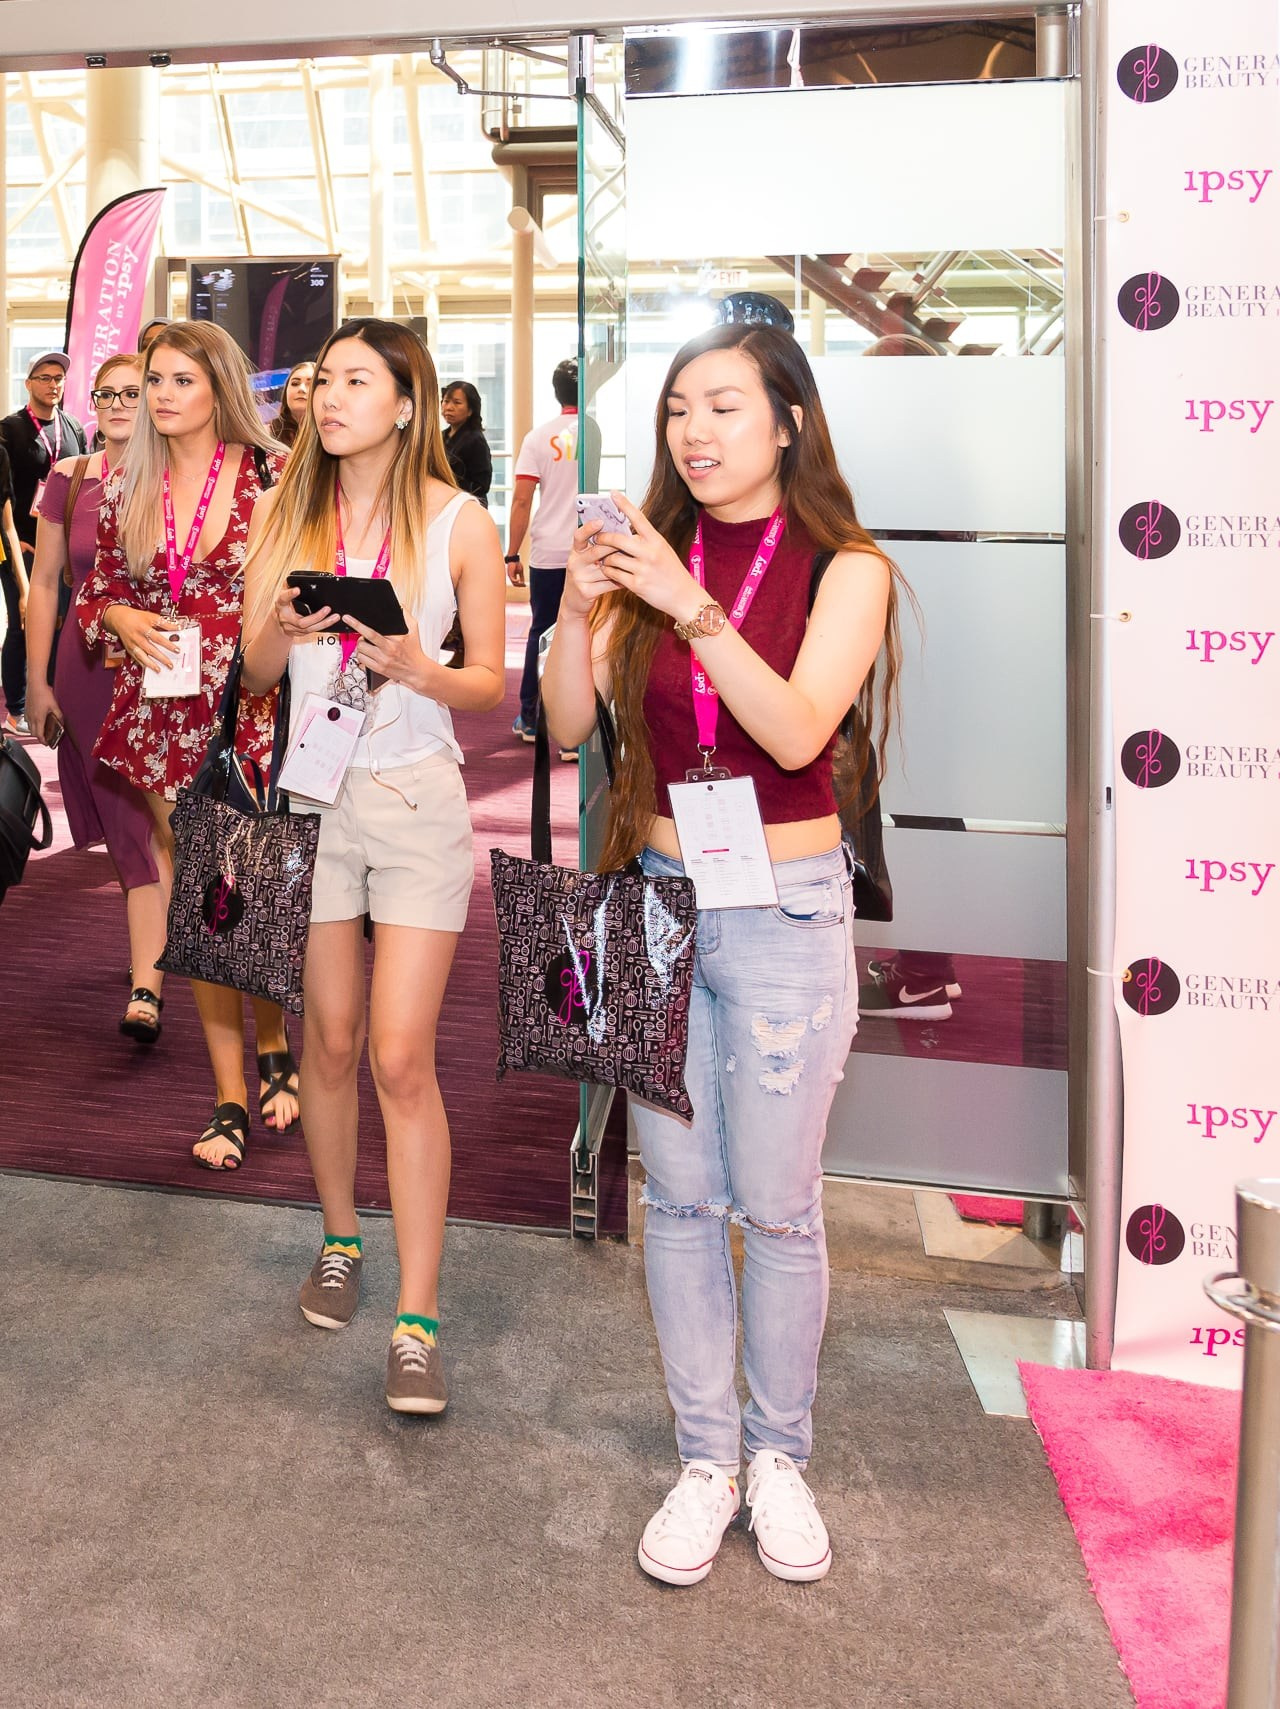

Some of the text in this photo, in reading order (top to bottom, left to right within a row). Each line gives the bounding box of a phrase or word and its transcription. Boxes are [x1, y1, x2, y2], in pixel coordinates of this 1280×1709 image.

[1185, 72, 1269, 88] BEAUTY
[1184, 169, 1273, 203] ipsy
[117, 244, 139, 299] ipsy
[1187, 303, 1271, 317] BEAUTY
[1185, 399, 1275, 433] ipsy
[1188, 533, 1271, 547] BEAUTY
[317, 635, 342, 646] HO
[1185, 629, 1276, 665] ipsy
[1188, 763, 1271, 779] BEAUTY
[1185, 858, 1276, 896] ipsy
[1188, 991, 1272, 1011] BEAUTY
[1187, 1103, 1278, 1144] ipsy
